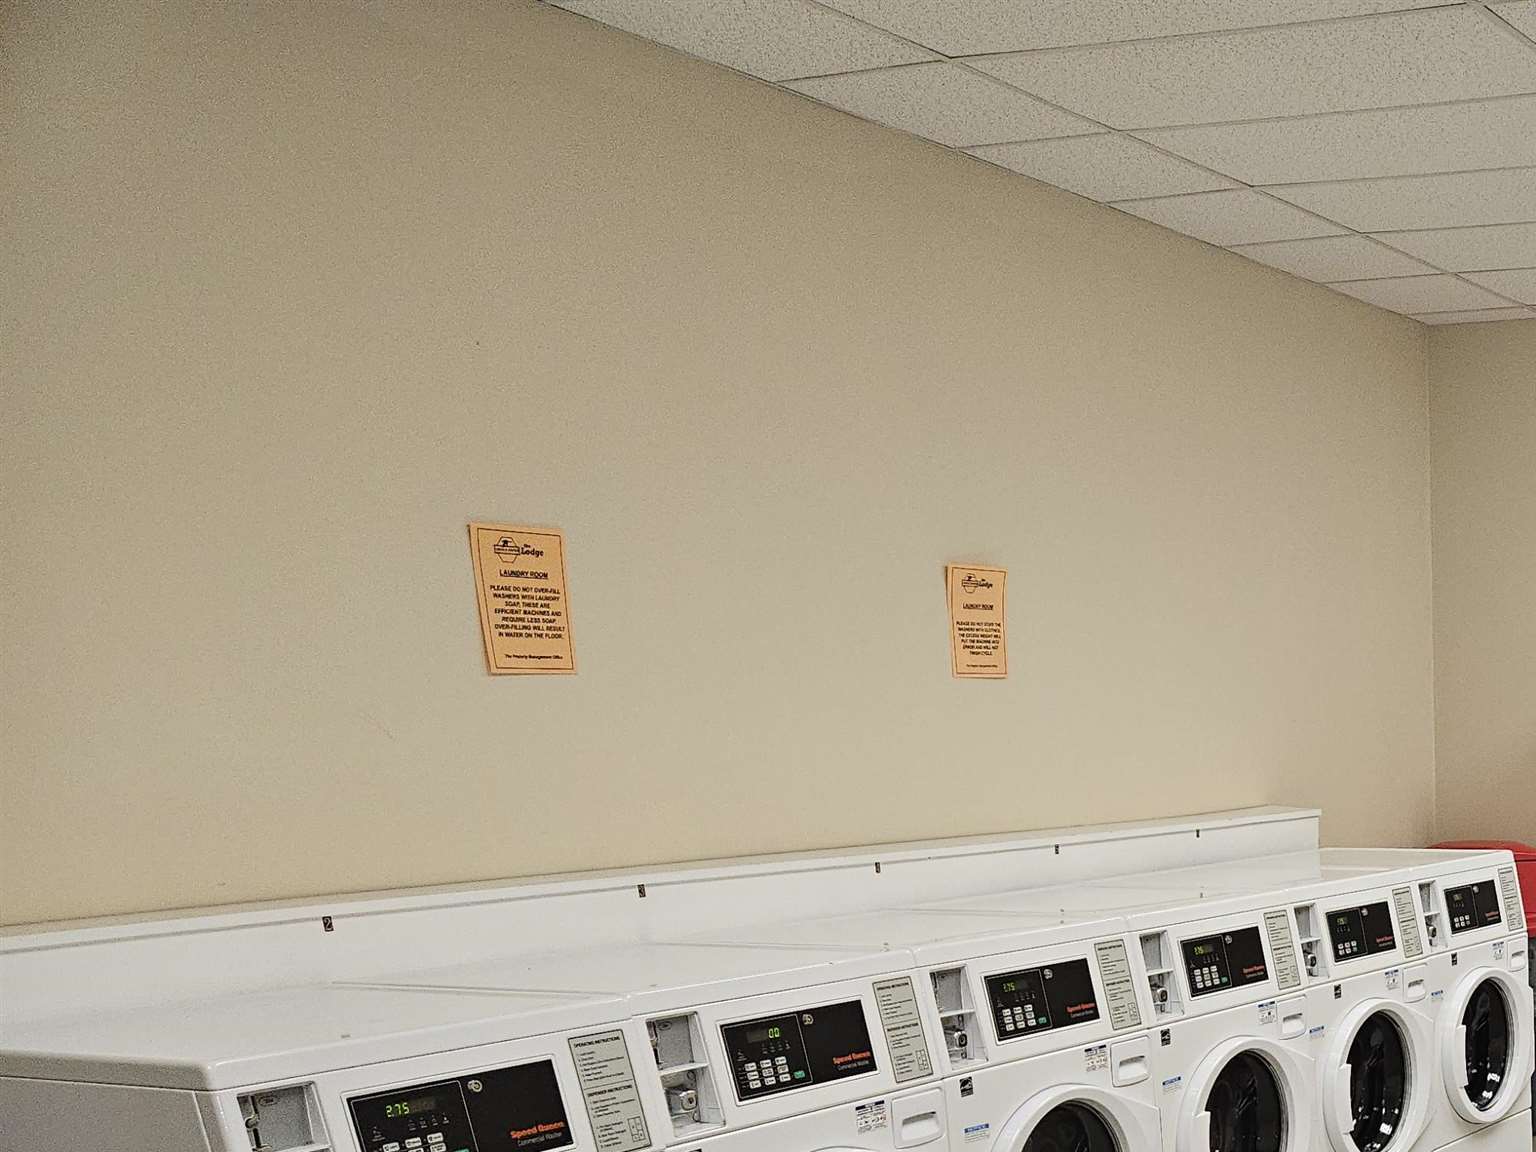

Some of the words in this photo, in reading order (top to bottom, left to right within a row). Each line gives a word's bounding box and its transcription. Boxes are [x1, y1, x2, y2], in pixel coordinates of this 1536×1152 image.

[521, 547, 544, 557] Lodge
[511, 1124, 537, 1139] Speed
[538, 1120, 565, 1134] Queen
